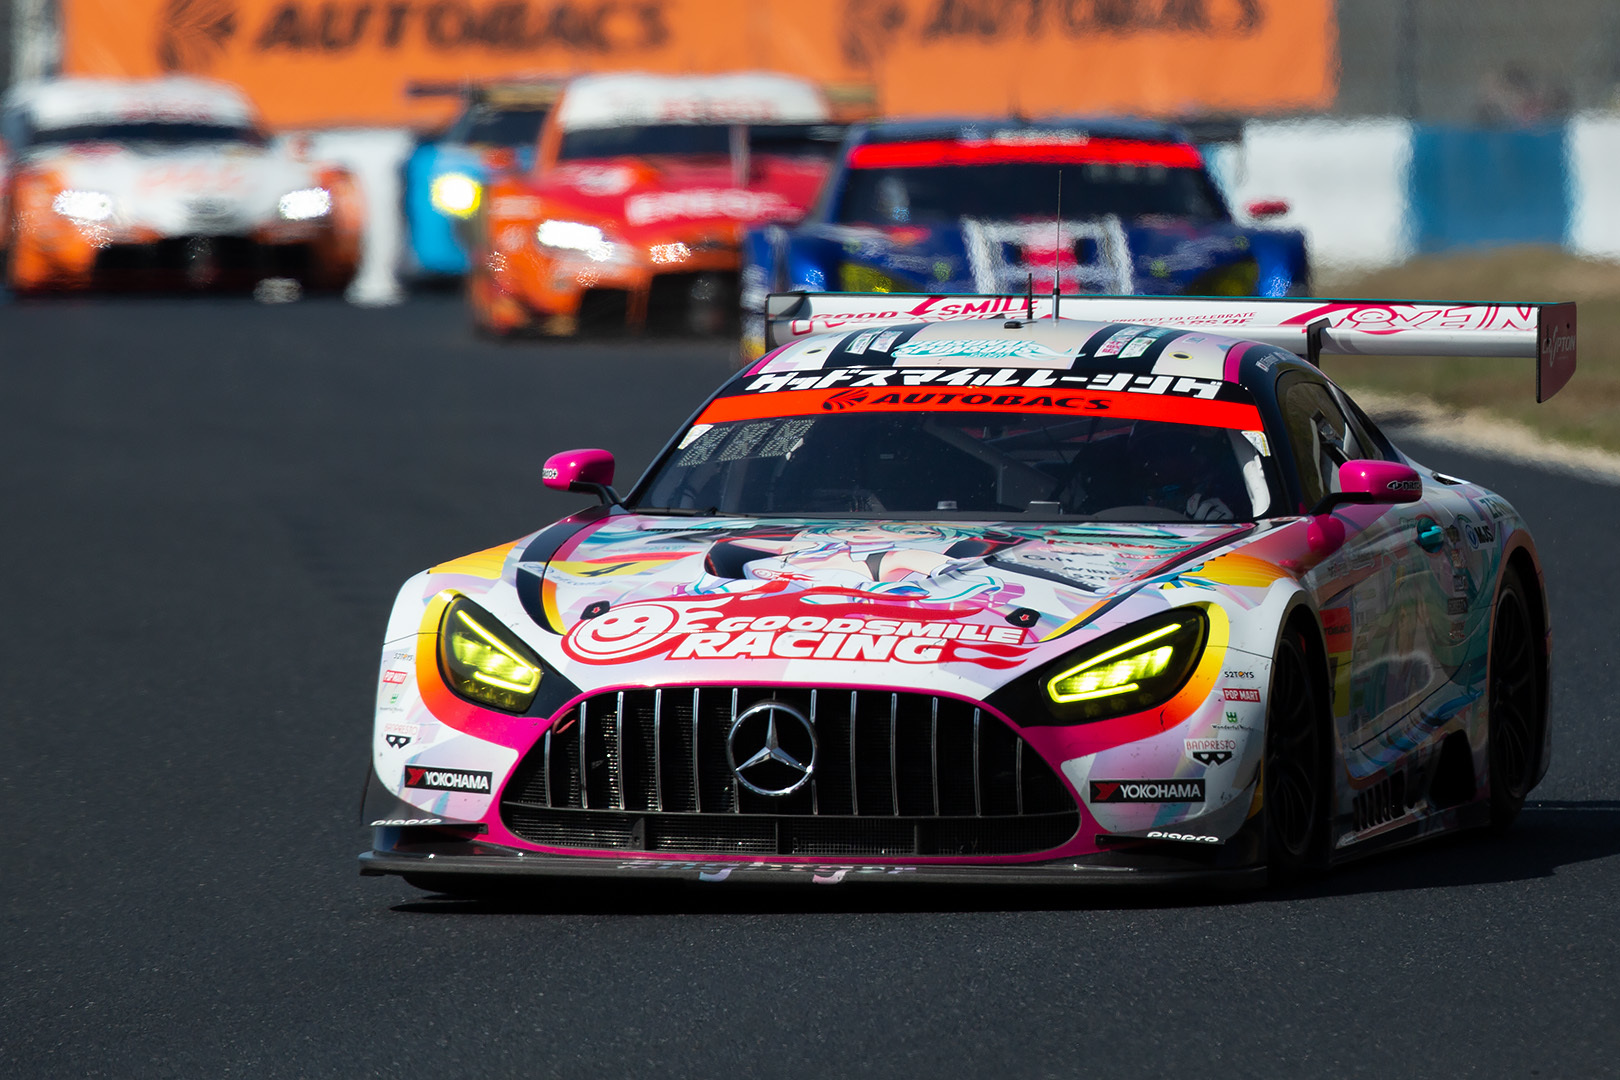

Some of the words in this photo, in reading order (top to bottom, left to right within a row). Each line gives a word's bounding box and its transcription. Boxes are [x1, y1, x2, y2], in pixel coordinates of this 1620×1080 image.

[1186, 311, 1257, 320] CELEBRATE
[745, 366, 1224, 400] グッドスマイルレーシング
[867, 393, 1112, 411] AUTOBACS
[715, 615, 1024, 645] GOODSMILE
[671, 631, 948, 662] RACING
[1224, 689, 1239, 699] POP
[1239, 690, 1259, 701] MART
[1186, 739, 1236, 750] BANPRESTO
[424, 771, 489, 789] YOKOHAMA
[1120, 783, 1202, 799] YOKOHAMA
